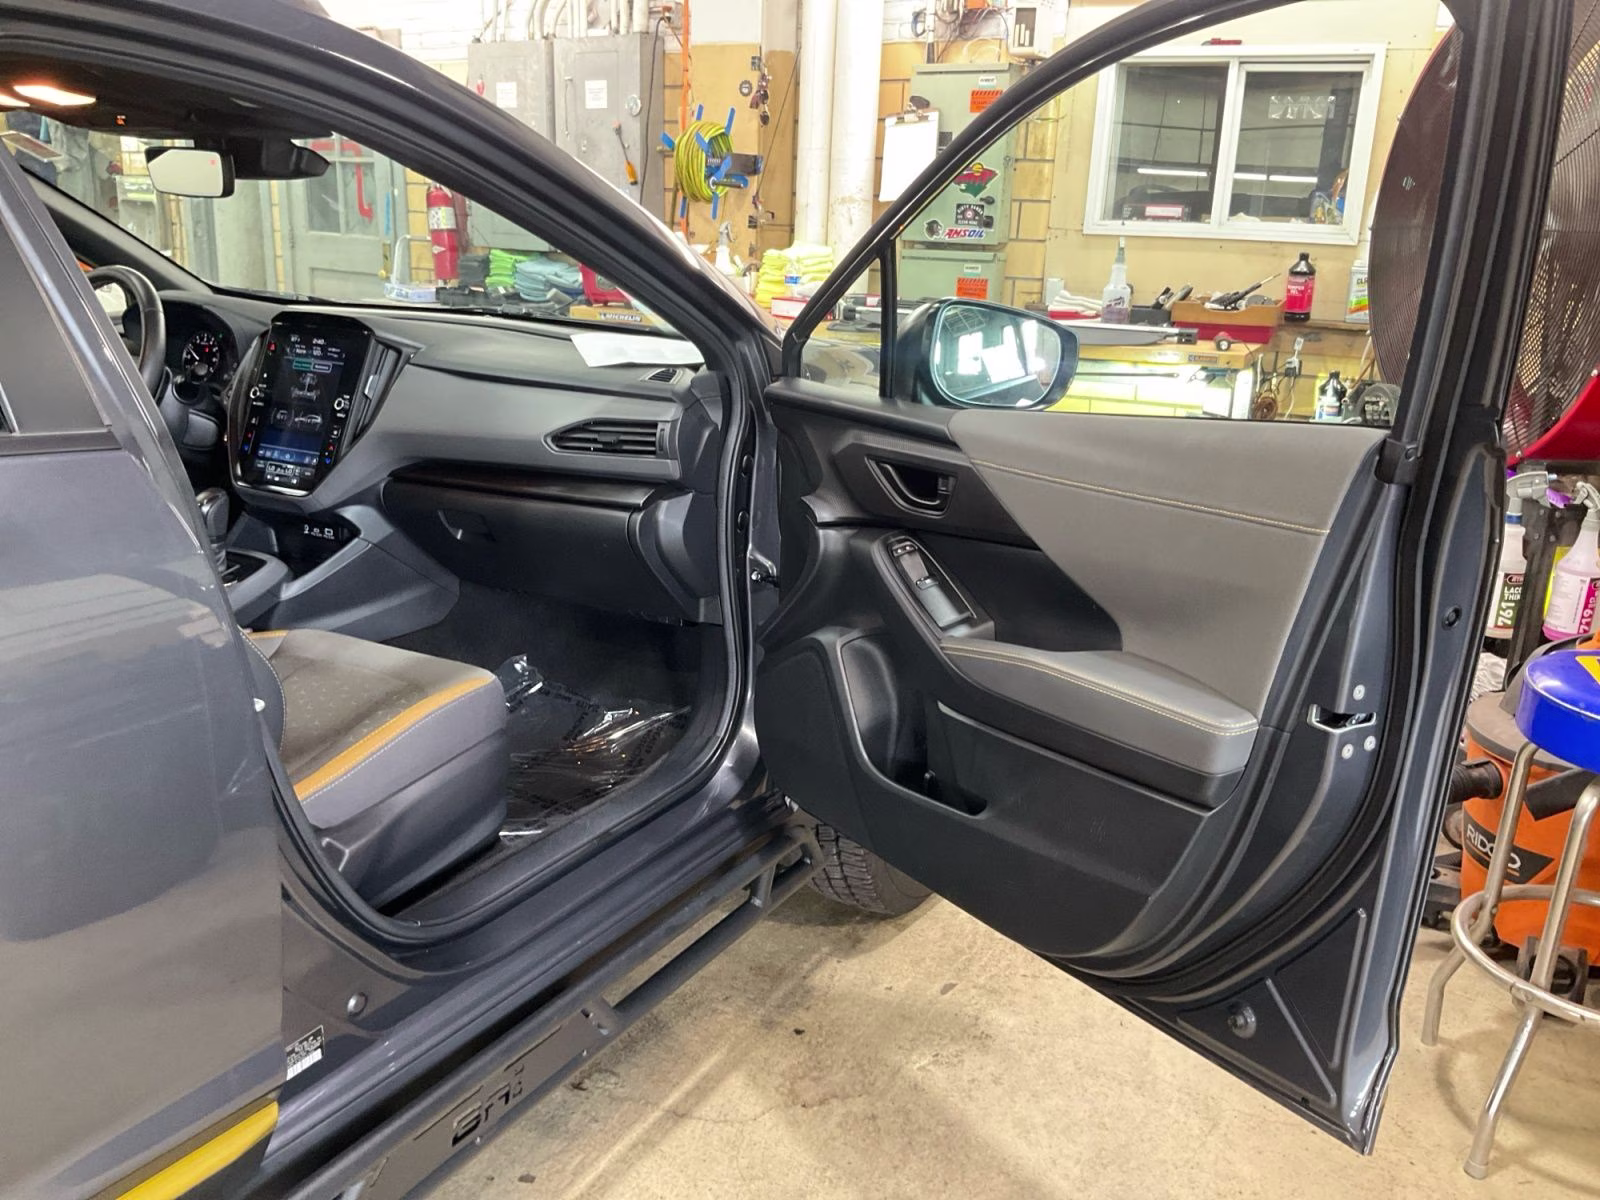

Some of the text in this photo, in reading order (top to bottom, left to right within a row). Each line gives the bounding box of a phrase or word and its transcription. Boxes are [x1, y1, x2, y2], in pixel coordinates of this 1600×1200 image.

[945, 228, 985, 239] AMSOIL
[1497, 601, 1516, 626] 761
[1579, 609, 1593, 634] 719
